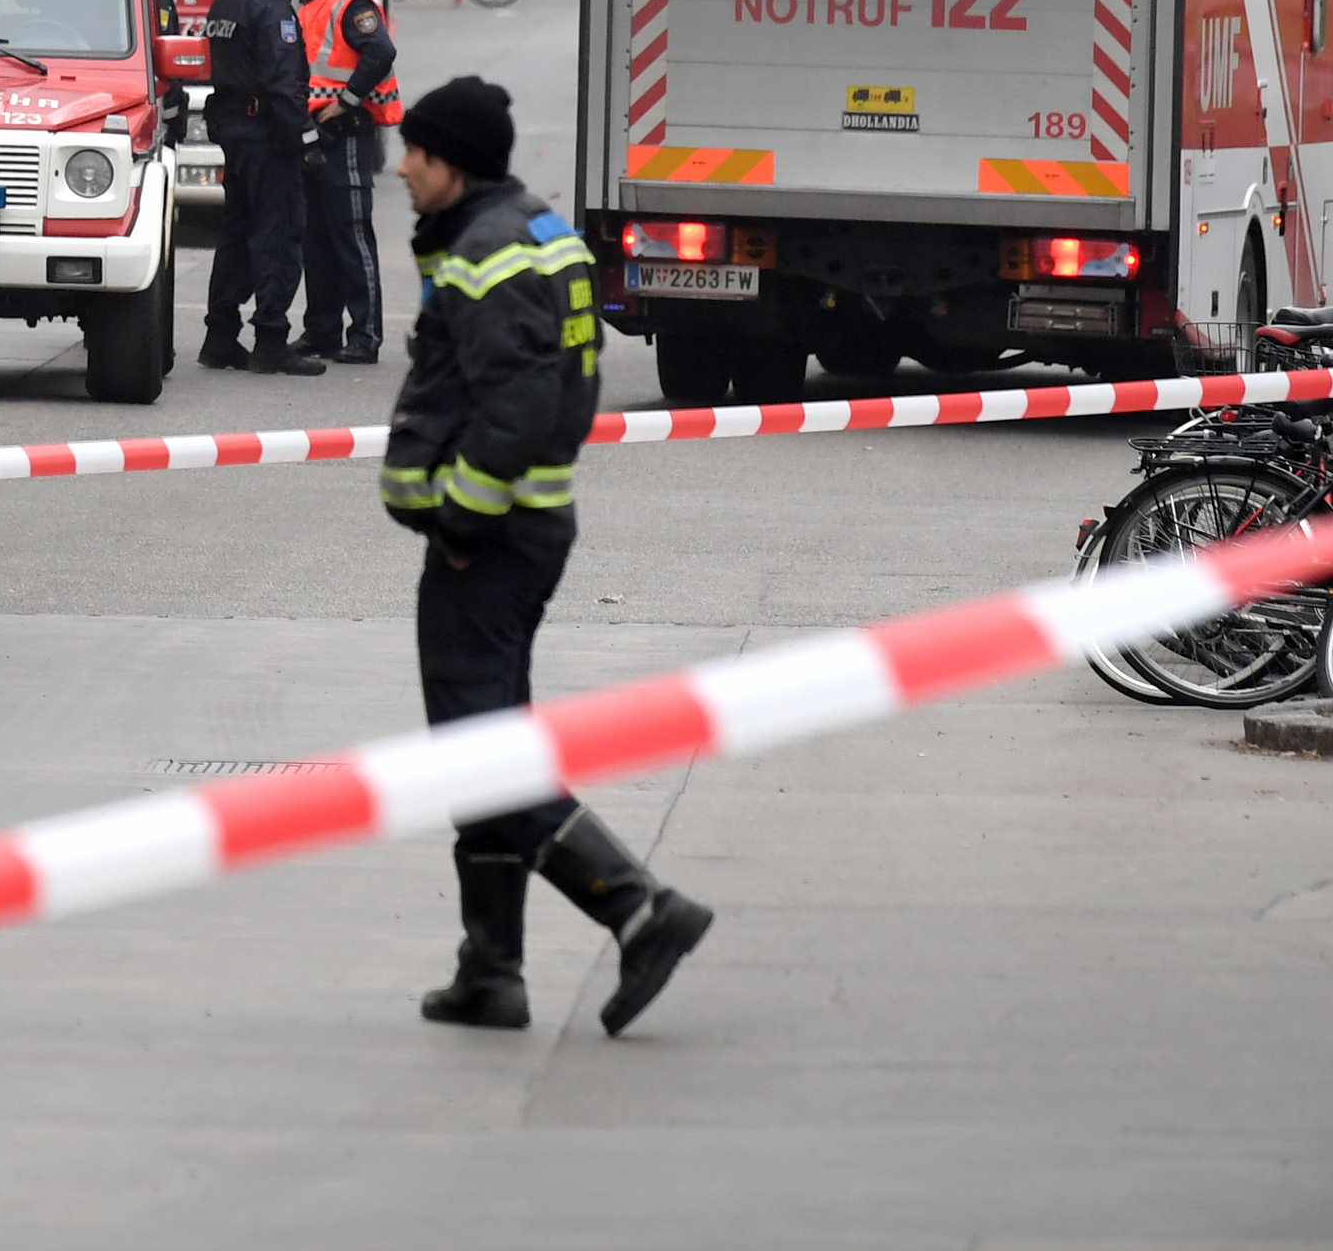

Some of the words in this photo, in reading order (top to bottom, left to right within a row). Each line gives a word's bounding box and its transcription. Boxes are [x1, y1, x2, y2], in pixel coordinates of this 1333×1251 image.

[1200, 16, 1242, 113] UMF
[3, 112, 42, 125] 123
[843, 114, 919, 130] DHOLLANDIA
[1028, 111, 1087, 140] 189
[640, 267, 654, 286] W
[671, 269, 719, 288] 2263
